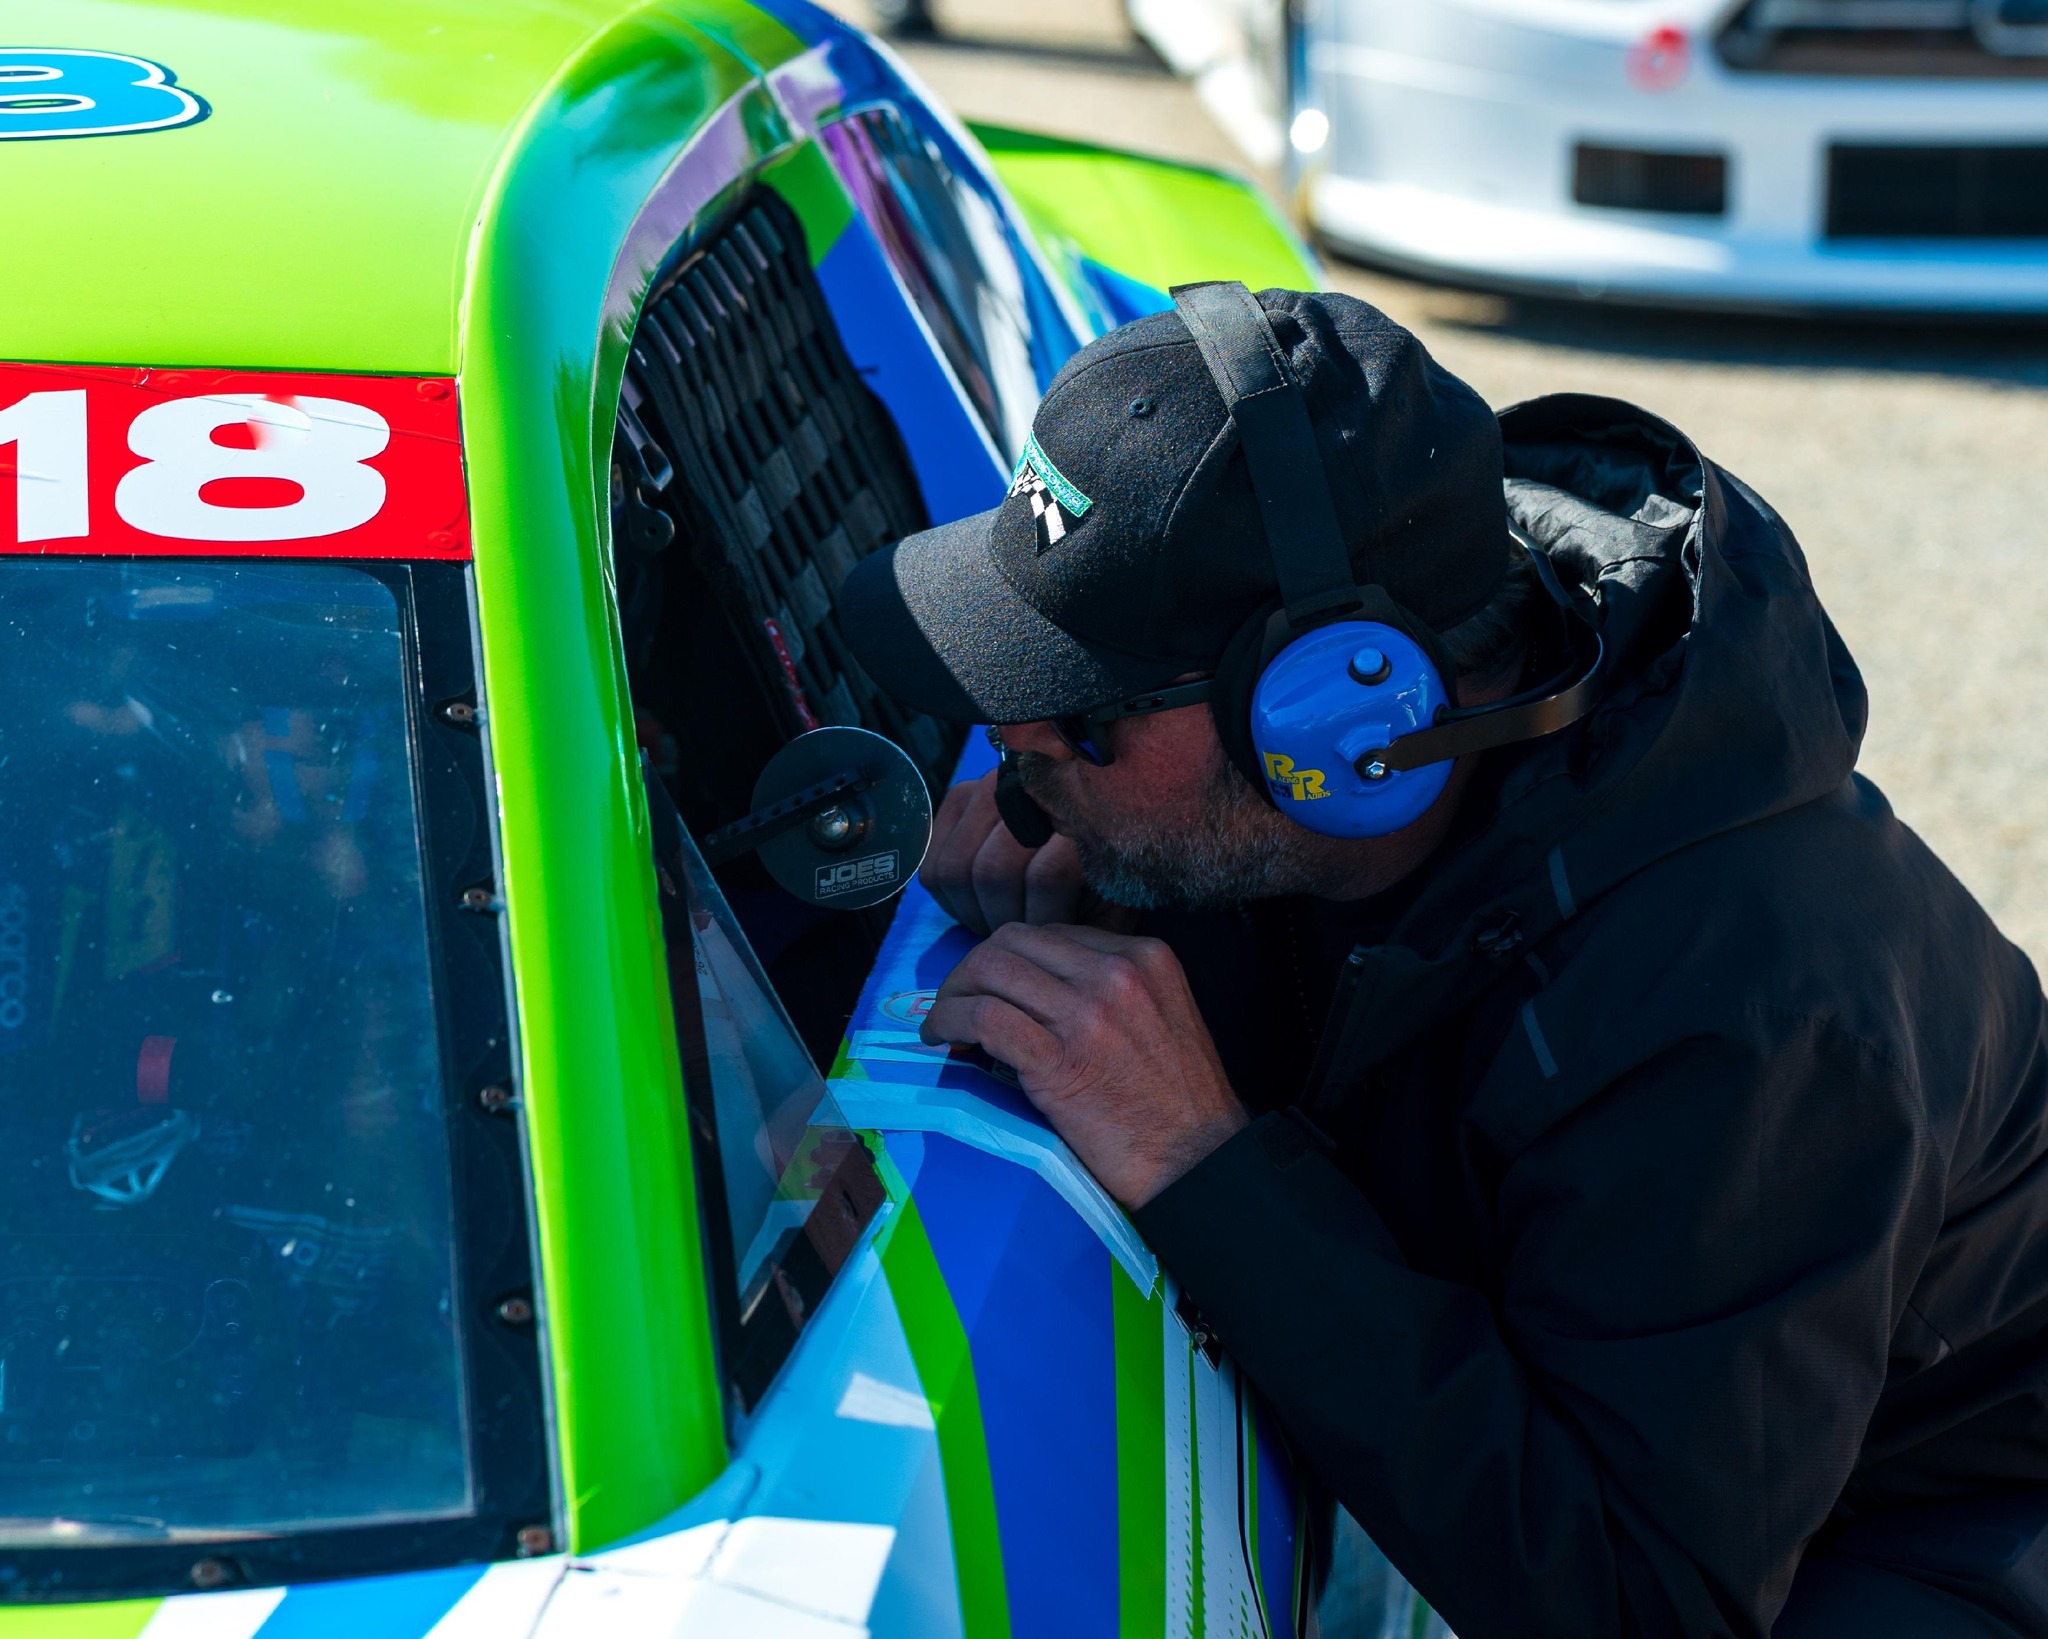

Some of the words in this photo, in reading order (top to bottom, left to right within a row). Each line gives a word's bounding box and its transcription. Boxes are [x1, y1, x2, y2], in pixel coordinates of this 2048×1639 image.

[819, 854, 895, 886] JOES
[819, 881, 851, 895] RACING
[852, 871, 895, 887] PRODUCTS
